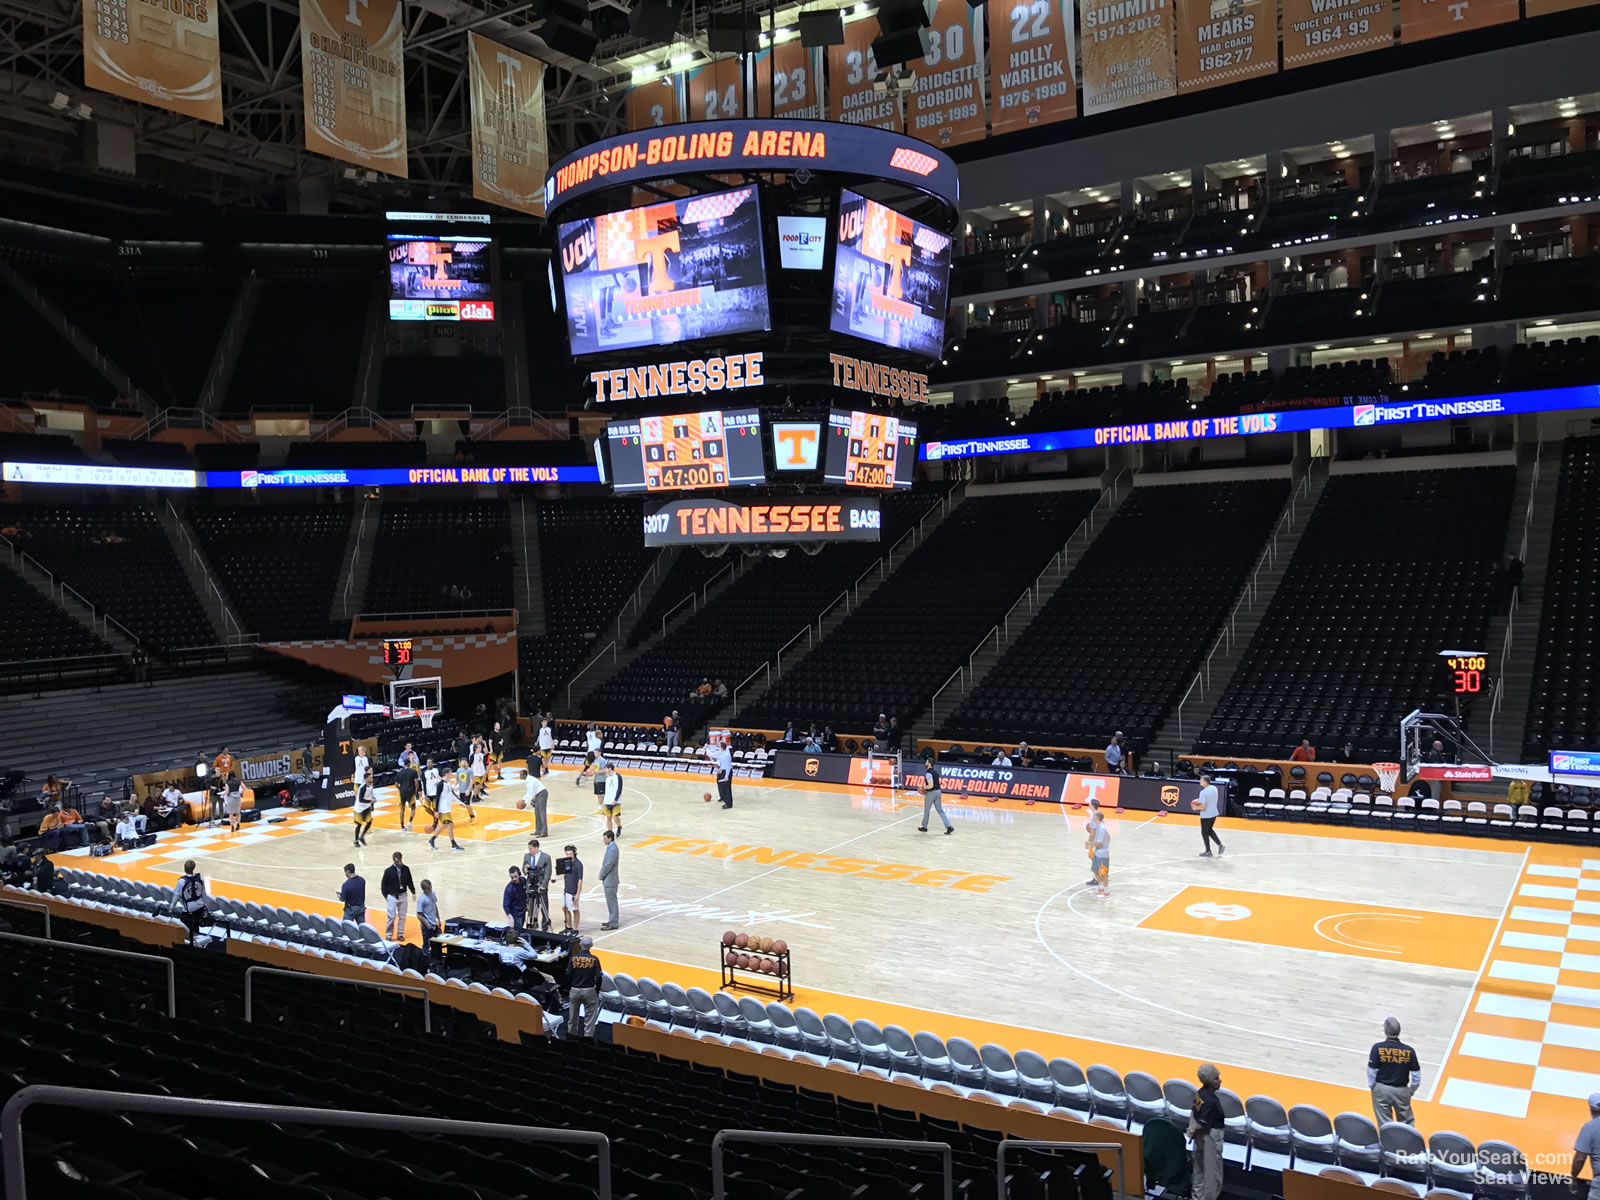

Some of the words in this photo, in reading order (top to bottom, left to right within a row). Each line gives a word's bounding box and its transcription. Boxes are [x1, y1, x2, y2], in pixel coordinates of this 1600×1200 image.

[97, 2, 127, 20] 1941
[1323, 15, 1335, 26] OF
[1337, 10, 1355, 22] THE
[1448, 2, 1469, 21] T
[97, 13, 128, 32] 1943
[1010, 0, 1050, 45] 22
[1093, 14, 1162, 42] 1974-2012
[1198, 15, 1255, 42] MEARS
[97, 25, 129, 44] 1979
[340, 31, 368, 51] SEC
[1304, 19, 1370, 47] 1964-99
[310, 32, 397, 77] CHAMPIONS
[923, 24, 965, 66] 30
[1200, 43, 1222, 55] HEAD
[1224, 35, 1253, 49] COACH
[311, 51, 335, 67] 1936
[1010, 43, 1053, 69] HOLLY
[1199, 47, 1253, 72] 1962-77
[311, 62, 333, 77] 1941
[496, 52, 521, 88] T
[911, 63, 981, 94] BRIDGETTE
[1000, 59, 1065, 89] WARLICK
[312, 72, 335, 88] 1943
[774, 67, 806, 106] 23
[1111, 72, 1158, 91] NATIONAL
[313, 83, 335, 99] 1967
[917, 83, 972, 110] GORDON
[1000, 82, 1068, 110] 1976-1980
[1088, 80, 1171, 106] CHAMPIONSHIPS
[313, 93, 336, 109] 1972
[704, 84, 738, 120] 24
[314, 104, 336, 119] 1977
[840, 101, 894, 124] CHARLES
[915, 103, 978, 129] 1985-1989
[314, 115, 336, 130] 1982
[556, 130, 734, 195] THOMPSON-BOLING
[742, 130, 826, 158] ARENA
[782, 234, 799, 242] FOOD
[809, 235, 822, 243] CITY
[118, 246, 141, 256] 331A
[312, 250, 328, 259] 331
[636, 230, 680, 291] T
[886, 243, 912, 299] T
[461, 304, 492, 319] dish
[624, 289, 701, 315] TENNESSEE
[591, 352, 764, 403] TENNESSEE
[830, 352, 928, 403] TENNESSEE
[679, 426, 685, 438] 1
[706, 416, 717, 433] A
[740, 427, 746, 437] 0
[751, 426, 757, 436] 0
[941, 443, 968, 456] FIRST
[1094, 426, 1151, 444] OFFICIAL
[1155, 421, 1189, 440] BANK
[1192, 419, 1209, 437] OF
[1212, 417, 1239, 435] THE
[1242, 414, 1277, 433] VOLS
[1375, 406, 1414, 421] FIRST
[622, 437, 628, 446] 0
[633, 436, 639, 446] 0
[709, 443, 718, 456] 0
[778, 429, 816, 464] T
[853, 442, 859, 455] 0
[651, 447, 659, 460] 0
[669, 451, 675, 461] 4
[693, 449, 700, 459] 4
[886, 446, 892, 459] 0
[13, 466, 24, 479] A
[258, 472, 285, 484] FIRST
[408, 469, 459, 483] OFFICIAL
[461, 469, 489, 483] BANK
[492, 468, 507, 482] OF
[508, 468, 529, 482] THE
[531, 467, 559, 482] VOLS
[663, 468, 709, 486] 47:00
[857, 466, 884, 484] 47:00
[397, 649, 410, 663] 30
[1448, 657, 1486, 670] 47:00
[1455, 670, 1480, 692] 30
[338, 741, 350, 755] T
[941, 766, 995, 780] WELCOME
[998, 771, 1013, 781] TO
[1495, 766, 1528, 775] SPALDING
[905, 774, 1008, 795] THOSON-BOLING
[1011, 783, 1050, 798] ARENA
[1081, 779, 1108, 803] T
[1163, 790, 1178, 804] ups
[630, 834, 1014, 893] TENNESSEE
[1378, 1047, 1411, 1058] EVENT
[1379, 1055, 1411, 1064] STAFF
